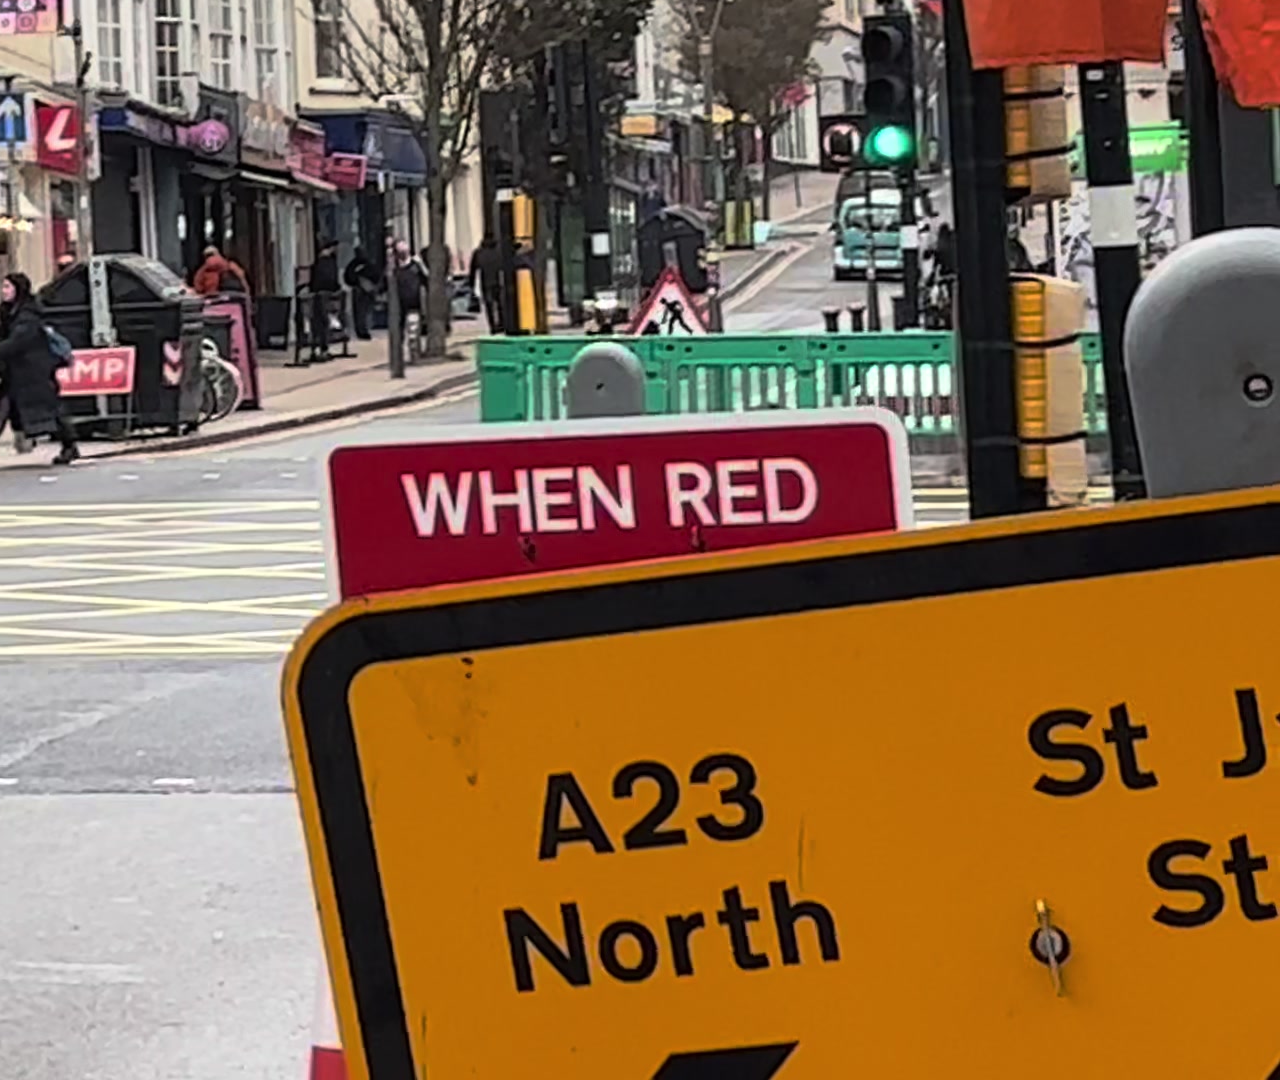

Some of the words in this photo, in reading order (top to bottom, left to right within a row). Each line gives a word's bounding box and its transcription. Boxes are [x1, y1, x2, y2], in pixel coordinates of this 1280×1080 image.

[401, 464, 636, 537] WHEN
[665, 457, 819, 528] RED
[1028, 702, 1159, 797] St
[1221, 688, 1280, 778] J
[539, 753, 764, 860] A23
[1147, 834, 1279, 929] St
[504, 880, 840, 993] North
